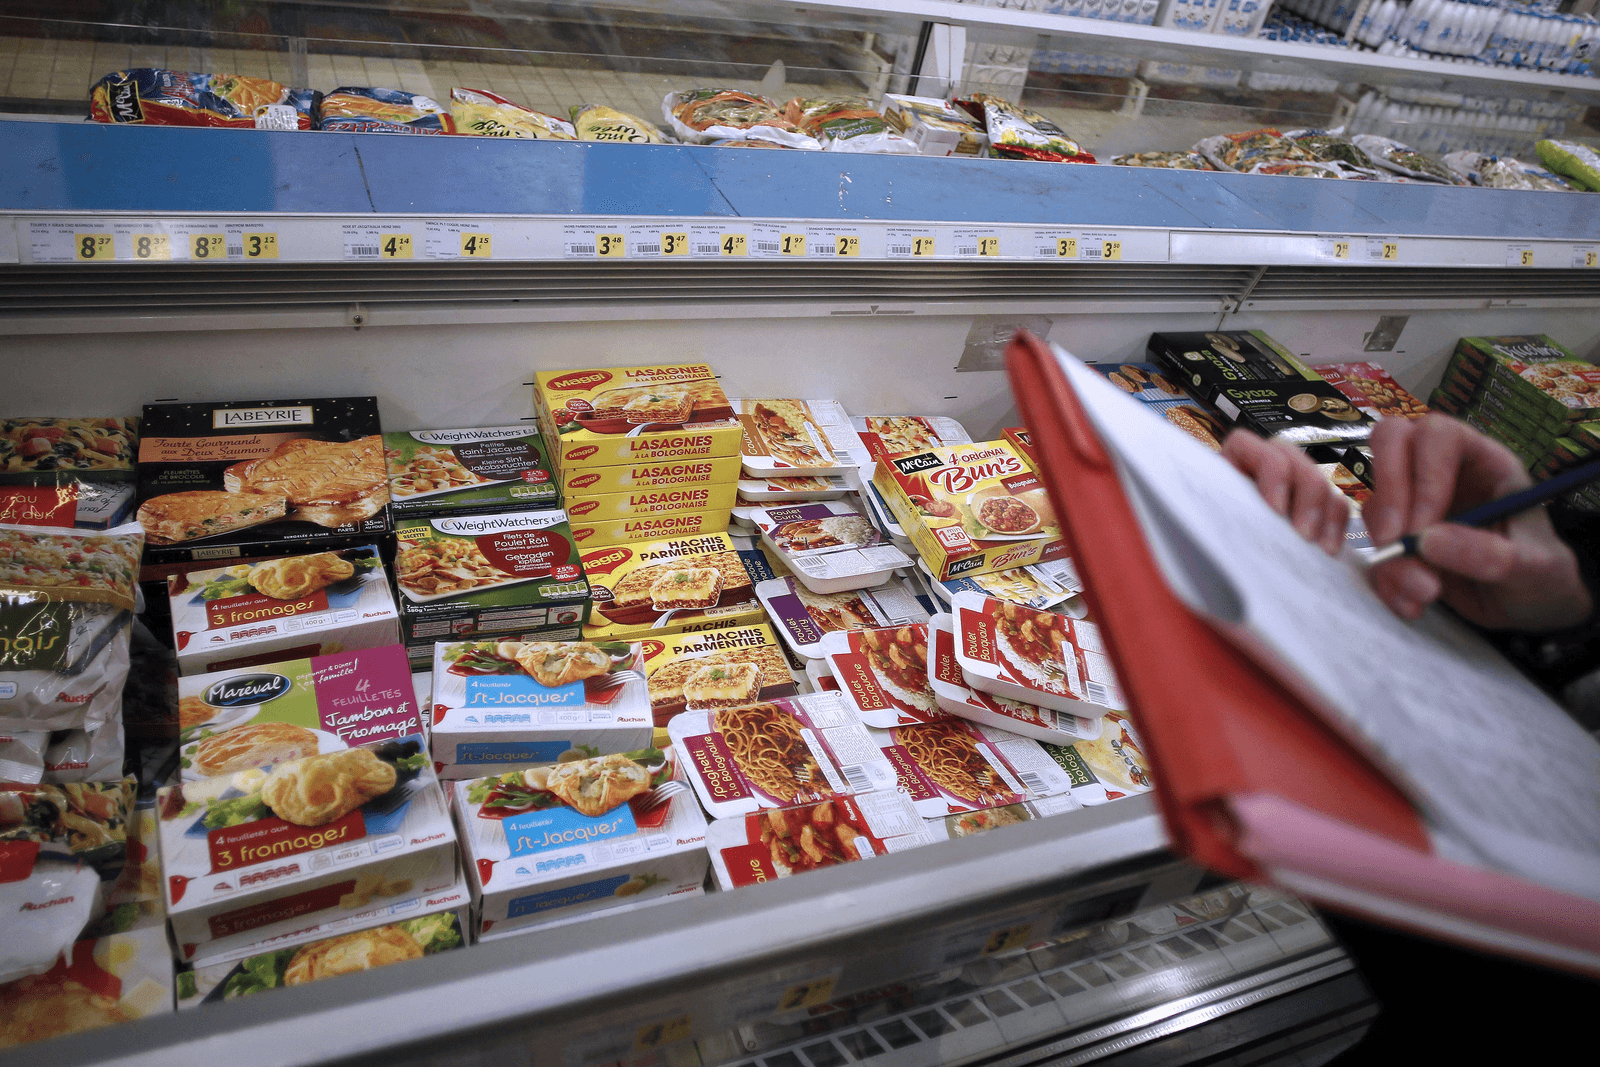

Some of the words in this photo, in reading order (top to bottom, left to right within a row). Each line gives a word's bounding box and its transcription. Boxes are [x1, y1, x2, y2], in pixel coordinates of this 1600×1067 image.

[81, 236, 96, 258] 8
[137, 236, 151, 258] 8
[195, 237, 209, 258] 8
[248, 236, 261, 256] 3
[384, 237, 397, 256] 4
[464, 236, 477, 254] 4
[599, 236, 610, 254] 3
[664, 235, 674, 253] 3
[723, 236, 734, 254] 4
[782, 236, 791, 253] 1
[838, 237, 848, 255] 2
[914, 239, 922, 255] 1
[980, 239, 988, 255] 1
[1059, 240, 1068, 256] 3
[1104, 242, 1112, 258] 3
[1336, 244, 1342, 258] 2
[1384, 245, 1391, 258] 2
[1522, 252, 1528, 264] 5
[625, 365, 709, 378] LASAGNES
[650, 372, 712, 382] BOLOGNAISE
[553, 372, 606, 389] Maggi
[1227, 388, 1278, 400] Gyoza
[225, 410, 302, 425] LABEYRIE
[153, 438, 192, 448] Tourte
[196, 436, 261, 449] Gourmande
[430, 428, 521, 442] WeightWatchers
[181, 448, 214, 456] Deux
[218, 446, 271, 456] Saumons
[630, 436, 713, 452] LASAGNES
[568, 446, 598, 459] Maggi
[650, 447, 710, 458] BOLOGNAISE
[948, 453, 958, 466] 4
[961, 448, 1006, 462] ORIGINAL
[632, 463, 712, 480] LASAGNES
[901, 458, 942, 472] McCain
[571, 475, 599, 488] Maggi
[652, 474, 710, 486] BOLOGNAISE
[929, 457, 1022, 493] Bun's
[1008, 477, 1038, 490] Bolognaise
[630, 489, 709, 506] LASAGNES
[570, 502, 598, 515] Maggi
[650, 500, 708, 512] BOLOGNAISE
[770, 508, 802, 517] Poulet
[453, 517, 550, 532] WeightWatchers
[624, 516, 702, 532] LASAGNES
[772, 513, 802, 522] Curry
[397, 526, 428, 534] NOUVELLE
[644, 526, 700, 538] BOLOGNAISE
[494, 539, 526, 548] Poulet
[528, 536, 548, 545] Rôti
[668, 536, 724, 549] HACHIS
[196, 548, 235, 558] LABEYRIE
[505, 551, 554, 561] Gebraden
[640, 544, 727, 561] PARMENTIER
[990, 547, 1038, 569] Bun's
[950, 558, 984, 574] McCain
[213, 614, 224, 626] 3
[231, 600, 314, 622] fromages
[220, 600, 253, 610] feuilletés
[362, 610, 392, 618] Auchan
[682, 619, 737, 634] HACHIS
[786, 617, 808, 643] Poulet
[799, 618, 818, 642] Curry
[704, 628, 763, 642] HACHIS
[978, 621, 991, 660] Basquaise
[672, 636, 767, 655] PARMENTIER
[967, 632, 978, 658] Poulet
[940, 654, 950, 680] Poulet
[355, 679, 370, 692] 4
[854, 663, 884, 708] Basquaise
[332, 689, 402, 708] FEUILLETÉS
[470, 691, 569, 704] St-Jacques
[851, 680, 873, 709] Poulet
[325, 704, 394, 728] Jambon
[396, 701, 410, 715] et
[617, 716, 646, 724] Auchan
[336, 716, 418, 742] Fromage
[704, 736, 733, 782] Bolognaise
[889, 747, 920, 785] Bolognaise
[694, 750, 728, 799] Spaghetti
[215, 836, 224, 845] 4
[226, 828, 269, 844] feuilletés
[410, 832, 446, 846] Auchan
[514, 822, 617, 852] St-Jacques
[217, 851, 233, 867] 3
[240, 826, 349, 861] fromages
[19, 896, 74, 912] Auchan
[426, 894, 461, 907] Auchan
